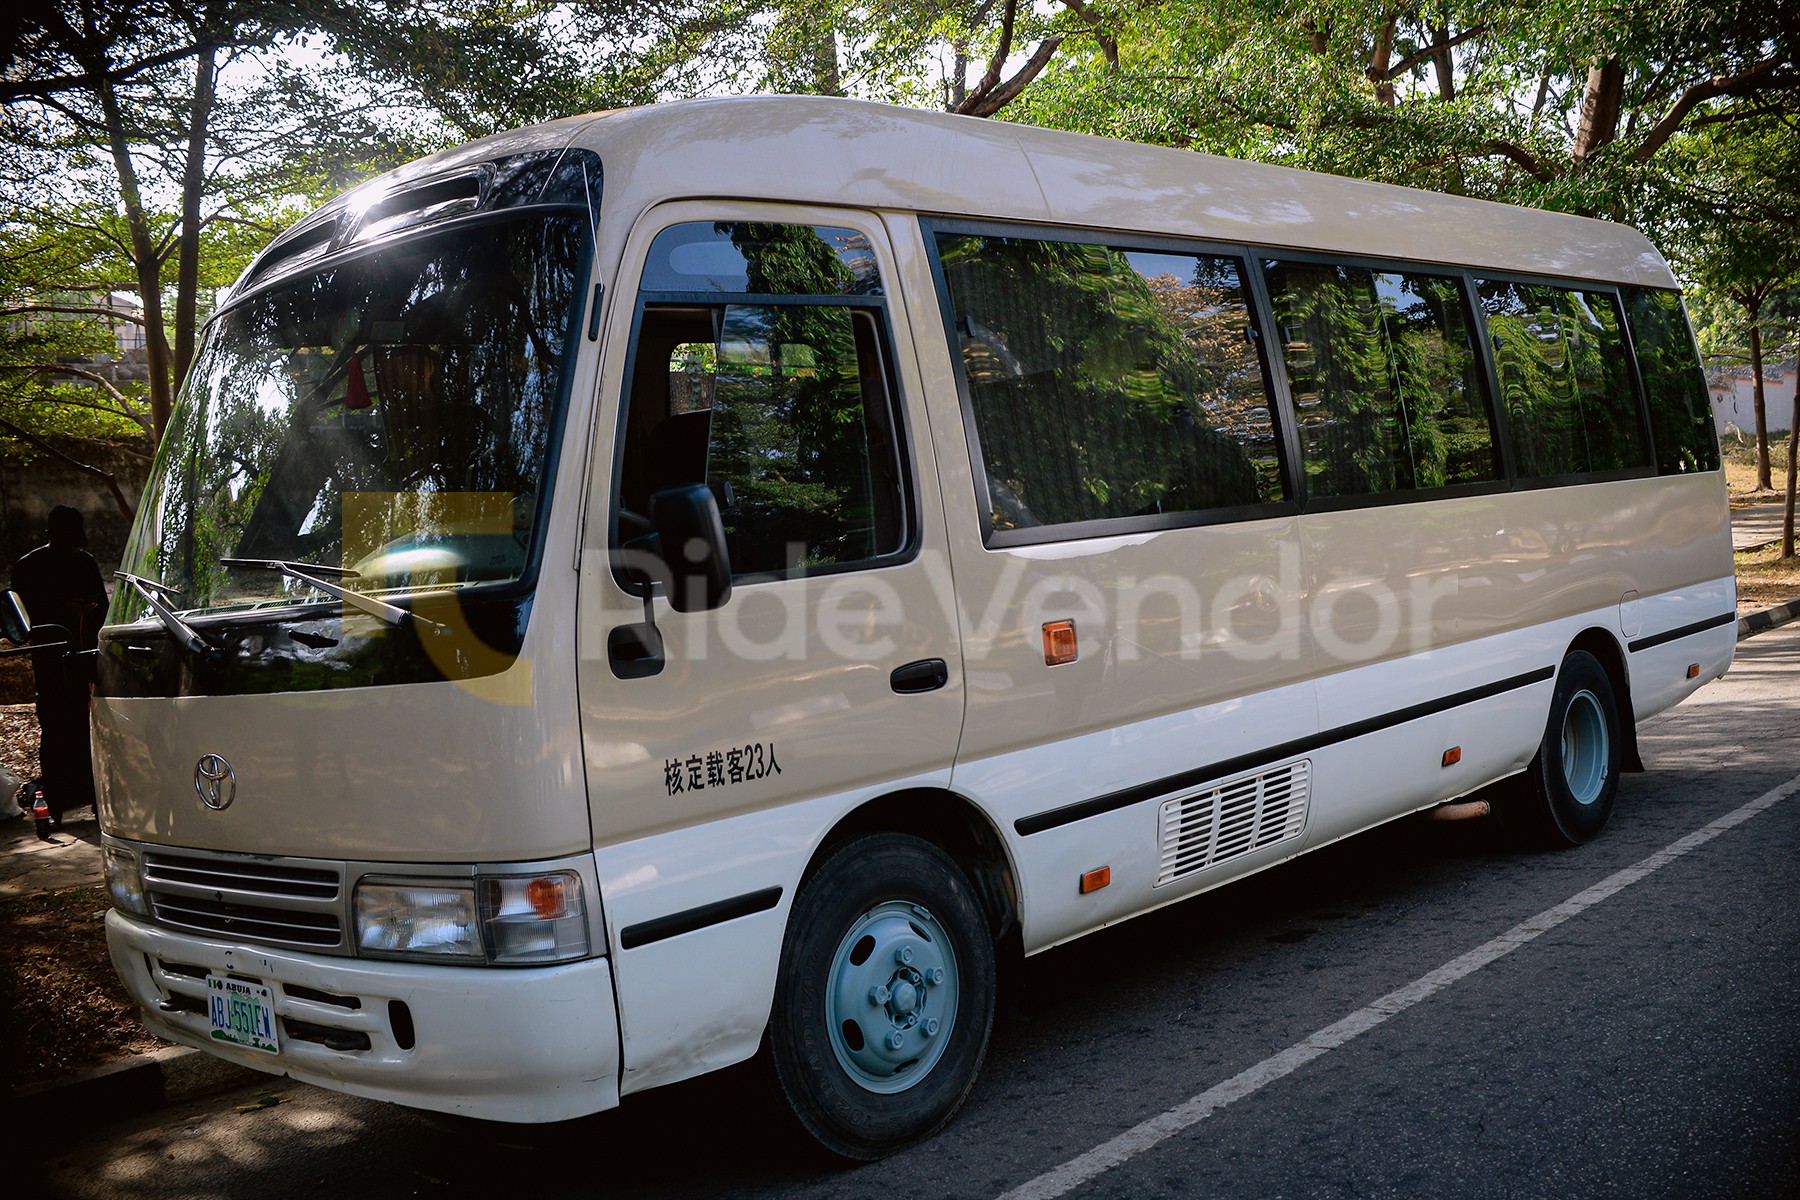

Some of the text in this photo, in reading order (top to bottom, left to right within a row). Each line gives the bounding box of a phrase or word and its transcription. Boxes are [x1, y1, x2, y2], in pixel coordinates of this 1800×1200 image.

[664, 742, 782, 796] 核定载客23人
[226, 983, 251, 994] ABUJA
